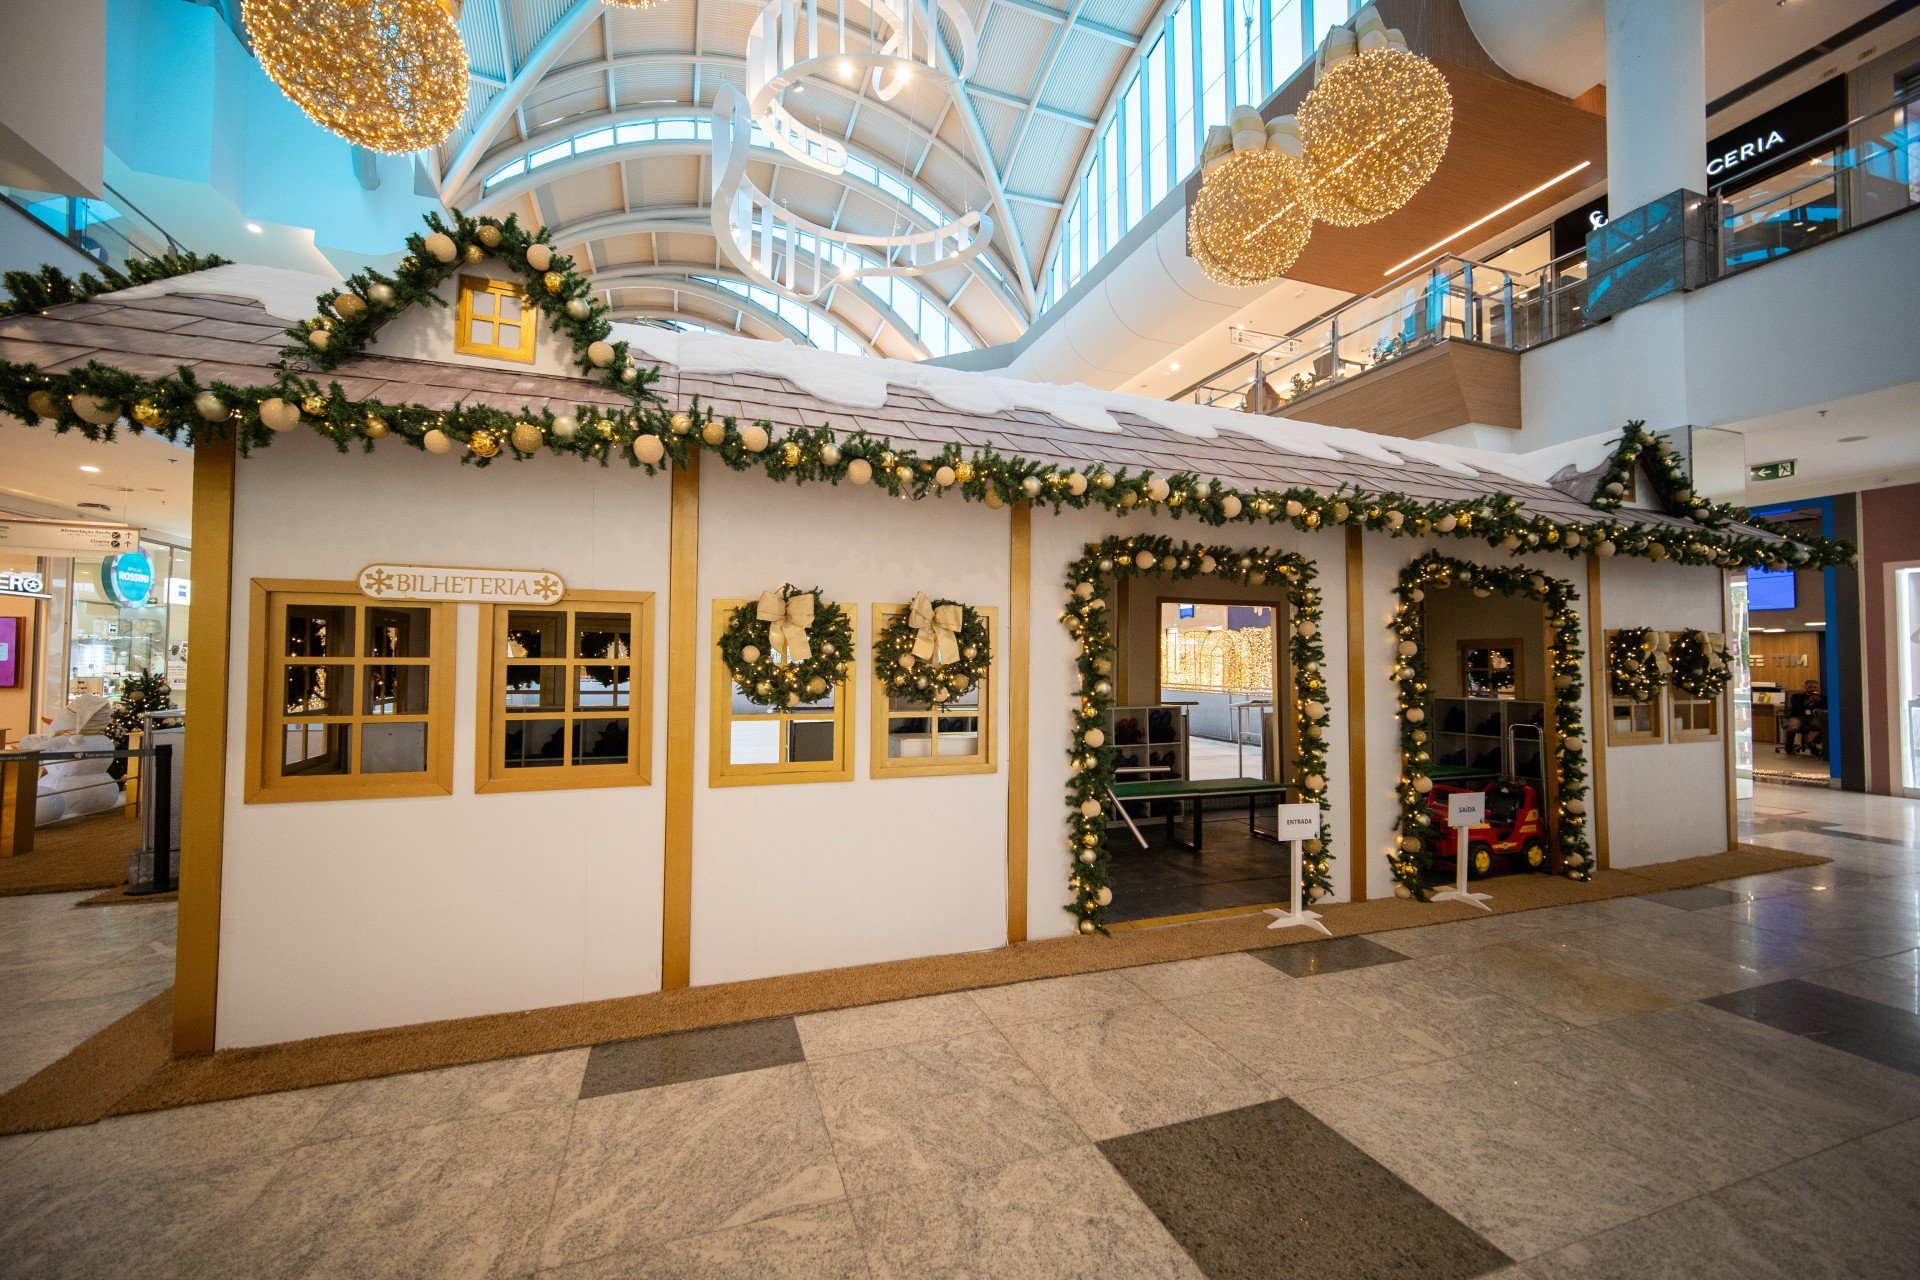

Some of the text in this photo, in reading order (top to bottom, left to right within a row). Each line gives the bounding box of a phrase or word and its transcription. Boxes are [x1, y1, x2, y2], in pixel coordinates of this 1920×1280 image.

[1706, 131, 1785, 175] CERIA
[118, 571, 149, 584] ROSSINI
[396, 573, 532, 596] BILHETERIA
[1772, 655, 1808, 667] TIM
[1458, 805, 1476, 813] SAÍDA
[1286, 818, 1312, 826] ENTRADA
